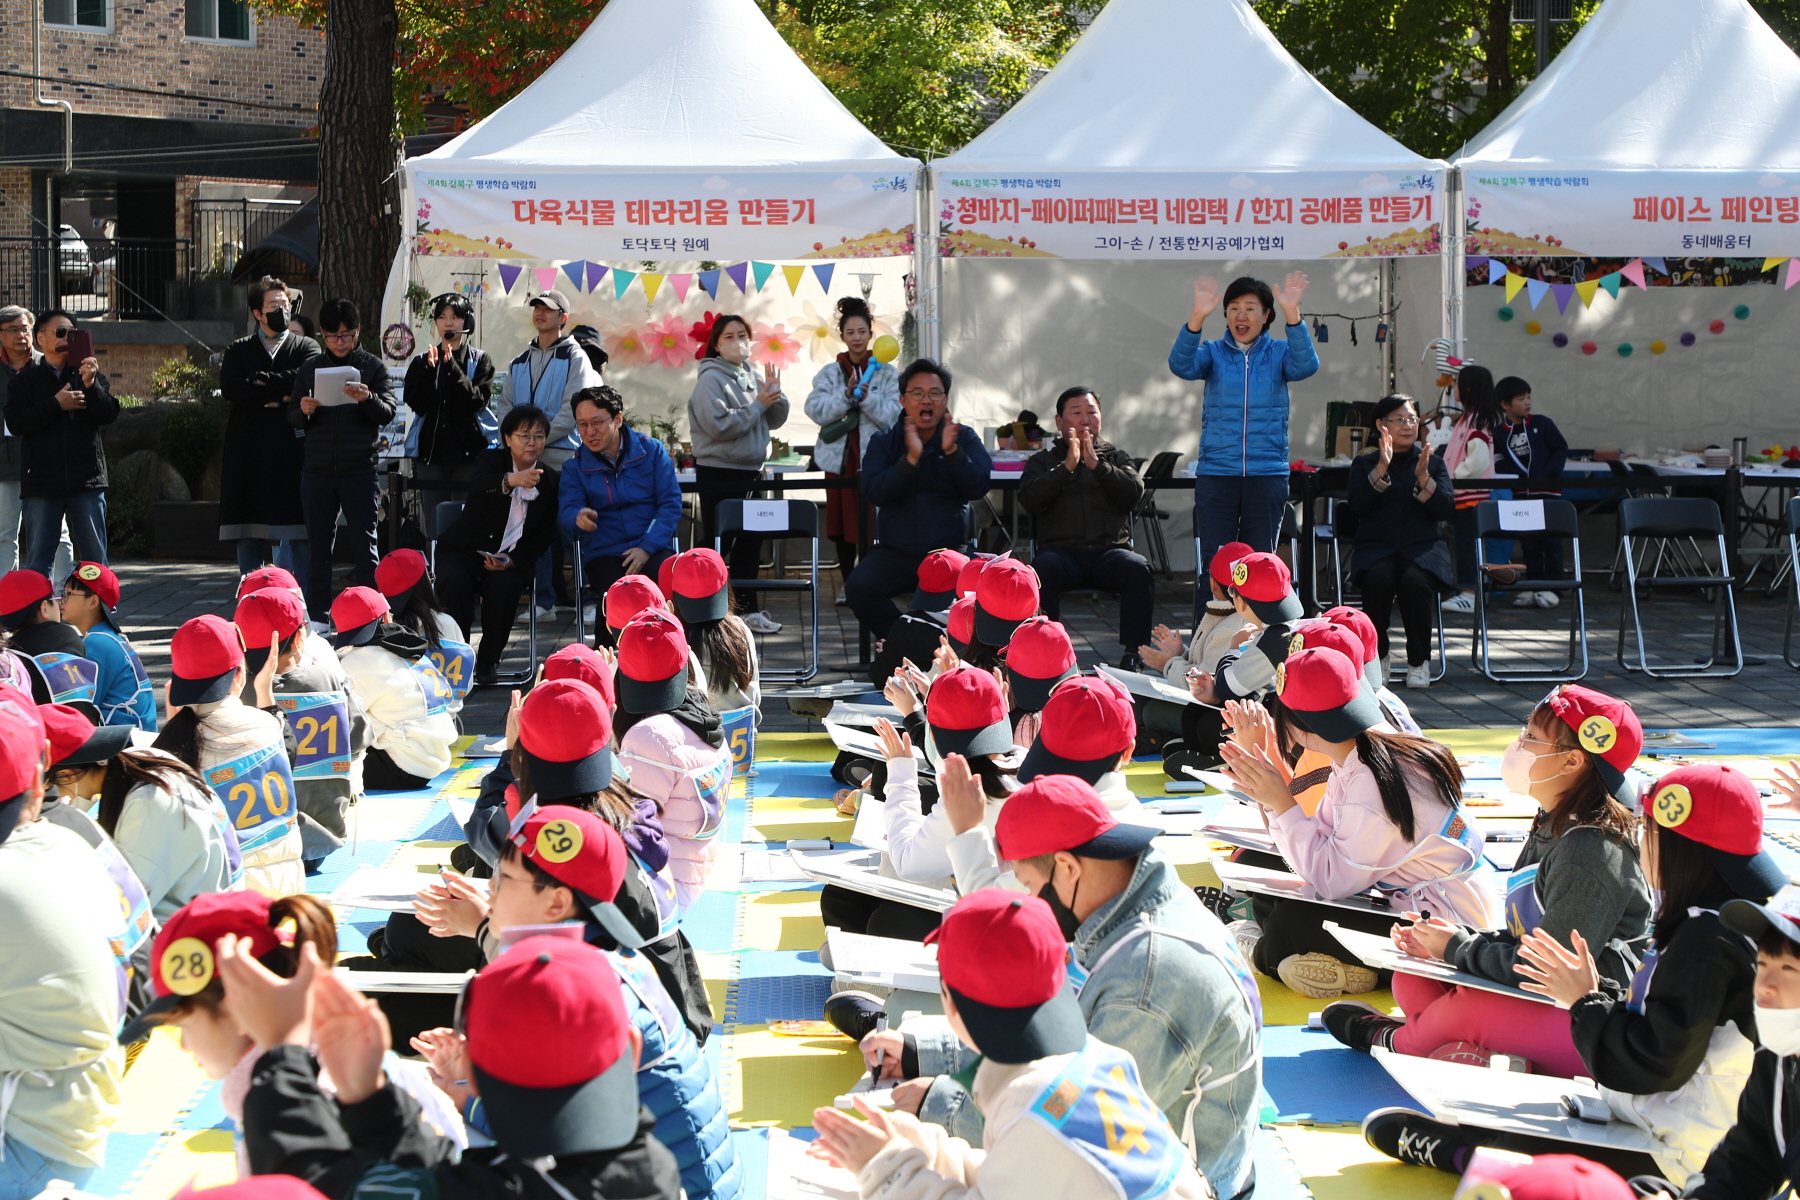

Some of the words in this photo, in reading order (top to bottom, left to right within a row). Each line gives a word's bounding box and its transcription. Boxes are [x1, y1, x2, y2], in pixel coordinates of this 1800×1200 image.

[427, 179, 447, 187] 제4회
[448, 179, 474, 189] 강북구
[476, 179, 510, 190] 평생학습
[511, 180, 537, 190] 박람회
[952, 179, 971, 187] 제4회
[973, 179, 998, 188] 강북구
[1000, 179, 1034, 188] 평생학습
[1036, 179, 1061, 188] 박람회
[1479, 177, 1499, 186] 제4회
[1501, 177, 1526, 186] 강북구
[1528, 177, 1562, 187] 평생학습
[1563, 177, 1589, 187] 박람회
[513, 199, 616, 226] 다육식물
[626, 199, 729, 226] 테라리움
[739, 198, 815, 226] 만들기
[957, 197, 1158, 225] 청바지-페이퍼패브릭
[1165, 198, 1229, 225] 네임택
[1251, 198, 1293, 225] 한지
[1299, 197, 1363, 225] 공예품
[1369, 195, 1433, 224] 만들기
[1633, 196, 1711, 223] 페이스
[1721, 196, 1799, 224] 페인팅
[621, 237, 677, 252] 토닥토닥
[682, 237, 710, 252] 원예
[1094, 235, 1144, 251] 그이-손
[1159, 235, 1285, 251] 전통한지공예가협회
[1681, 234, 1752, 250] 동네배움터
[83, 566, 97, 578] 12
[1235, 566, 1246, 581] 59
[63, 664, 85, 684] 11
[431, 652, 463, 686] 24
[296, 715, 338, 755] 21
[1583, 721, 1611, 748] 54
[228, 771, 289, 829] 20
[1658, 792, 1685, 823] 53
[544, 823, 573, 853] 29
[171, 953, 206, 980] 28
